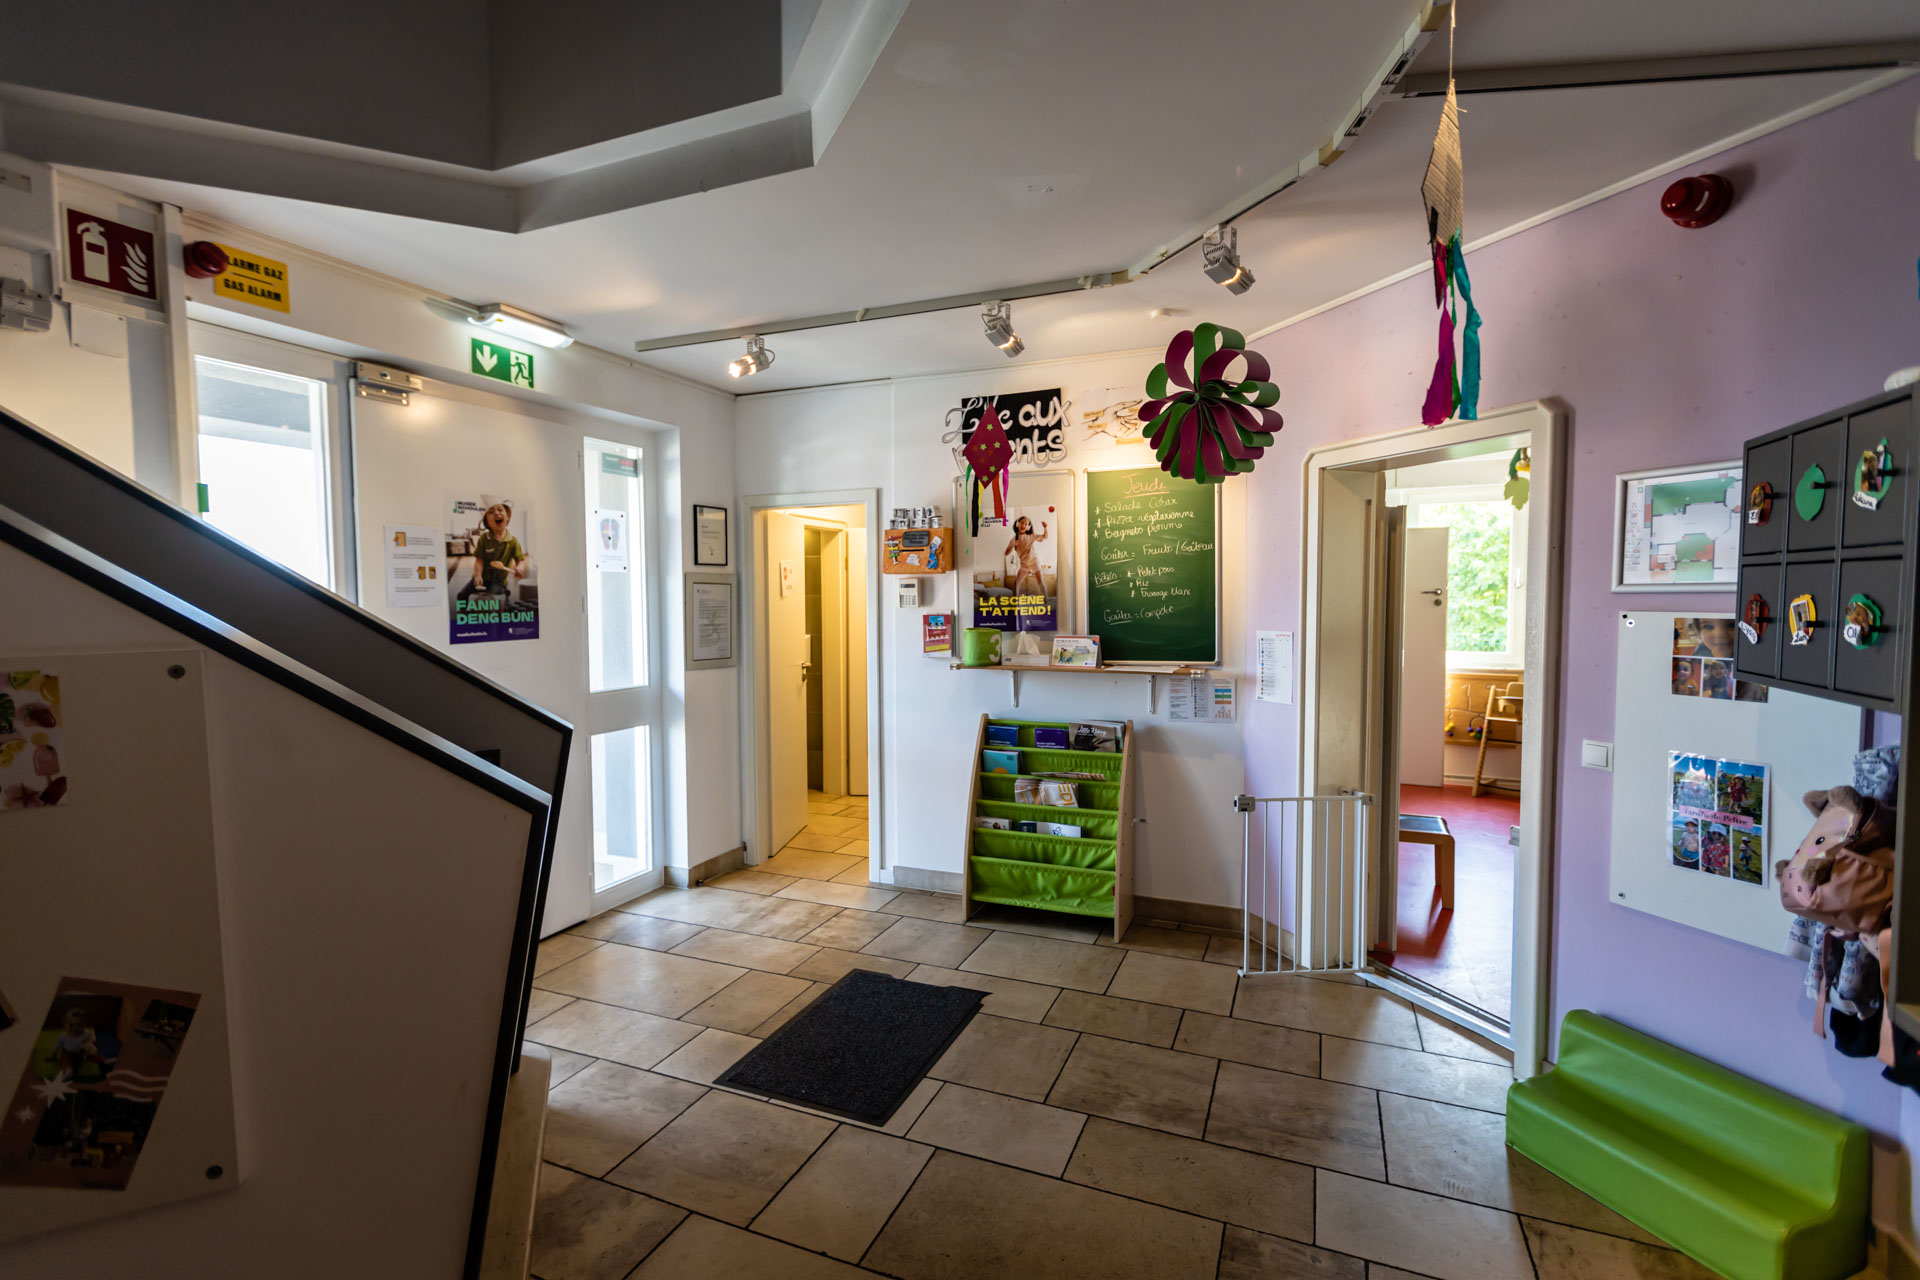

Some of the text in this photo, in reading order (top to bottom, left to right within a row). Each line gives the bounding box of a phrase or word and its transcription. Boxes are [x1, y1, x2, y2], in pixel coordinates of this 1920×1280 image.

[227, 255, 284, 281] LARME GAZ
[224, 278, 282, 303] GAS ALARM
[1018, 396, 1072, 428] aux
[1104, 500, 1141, 513] Salade
[456, 599, 500, 612] FANN
[979, 594, 1045, 607] LA SCÈNE
[456, 612, 500, 625] DENG
